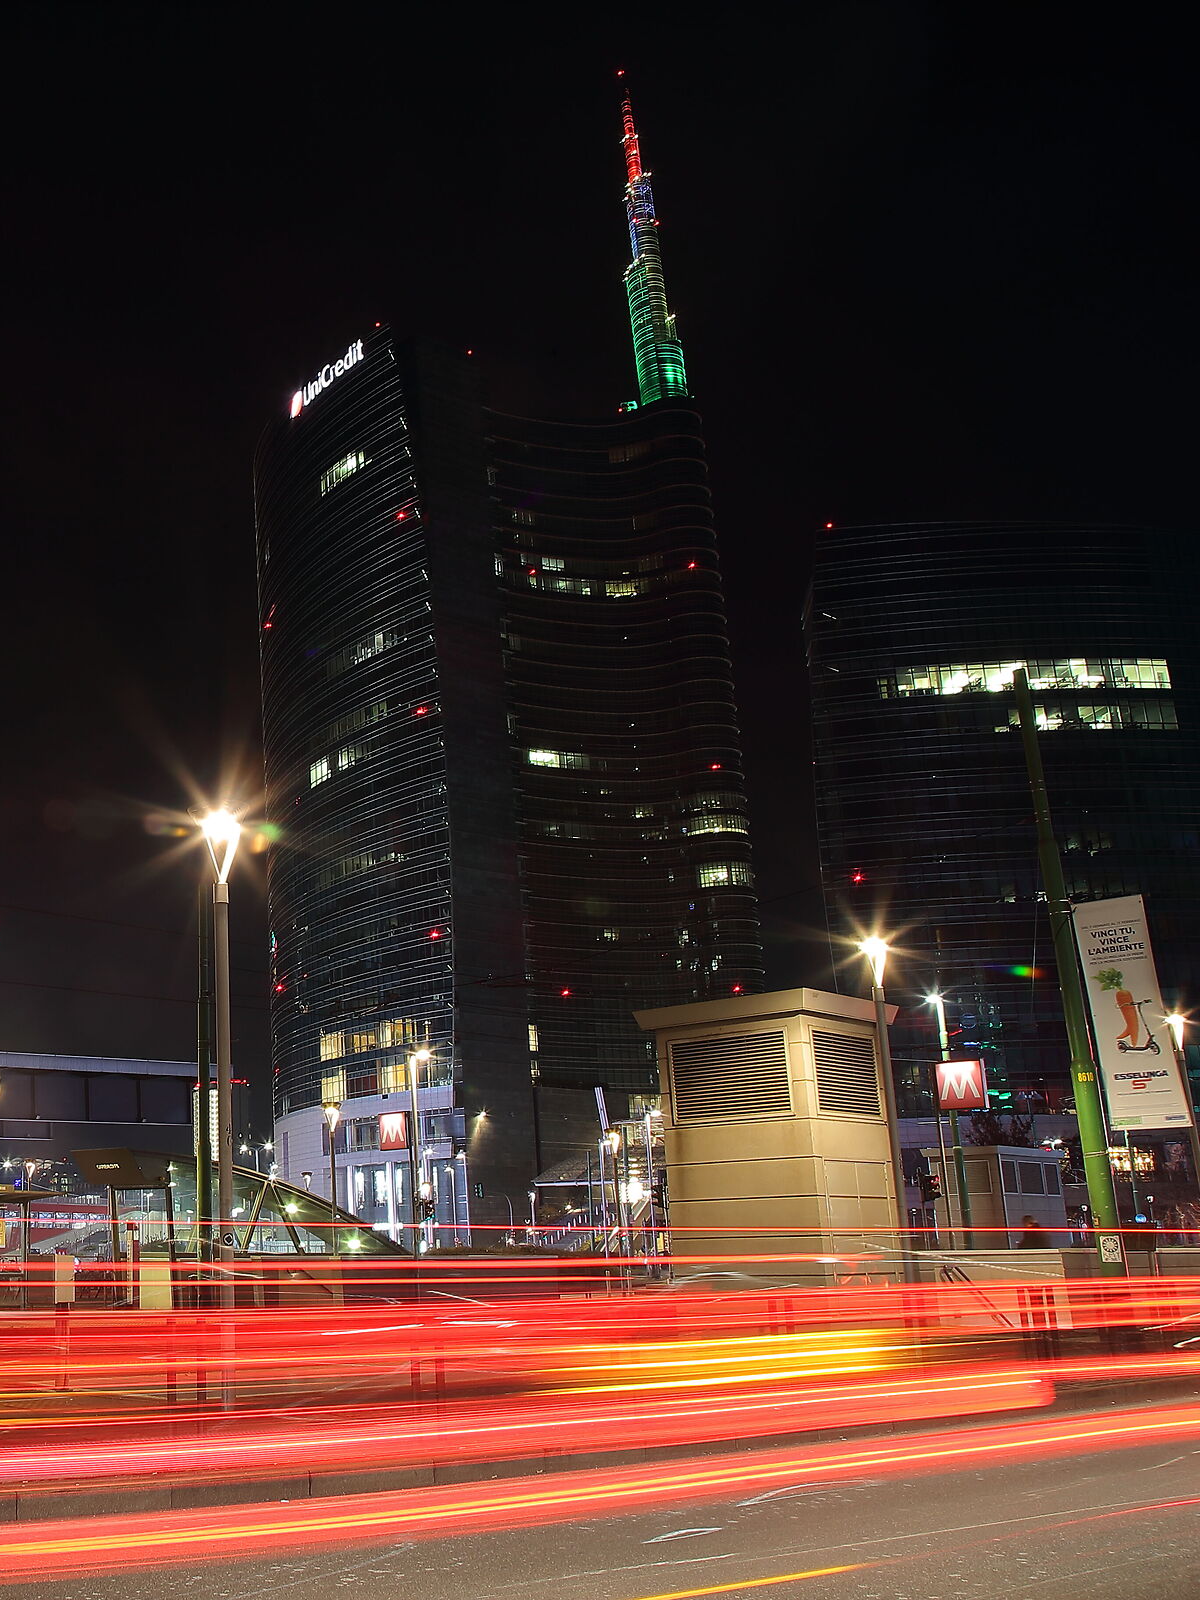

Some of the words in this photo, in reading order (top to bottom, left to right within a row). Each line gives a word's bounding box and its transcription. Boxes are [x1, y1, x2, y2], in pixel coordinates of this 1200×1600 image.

[303, 339, 364, 406] UniCredit
[1091, 928, 1117, 939] VINCI
[1119, 927, 1135, 935] TU,
[1100, 936, 1129, 945] VINCE
[1088, 942, 1144, 955] L'AMBIENTE
[1078, 1072, 1094, 1082] 8610
[1114, 1070, 1169, 1080] ESSELUNGA
[940, 1064, 981, 1100] M
[382, 1114, 405, 1143] M
